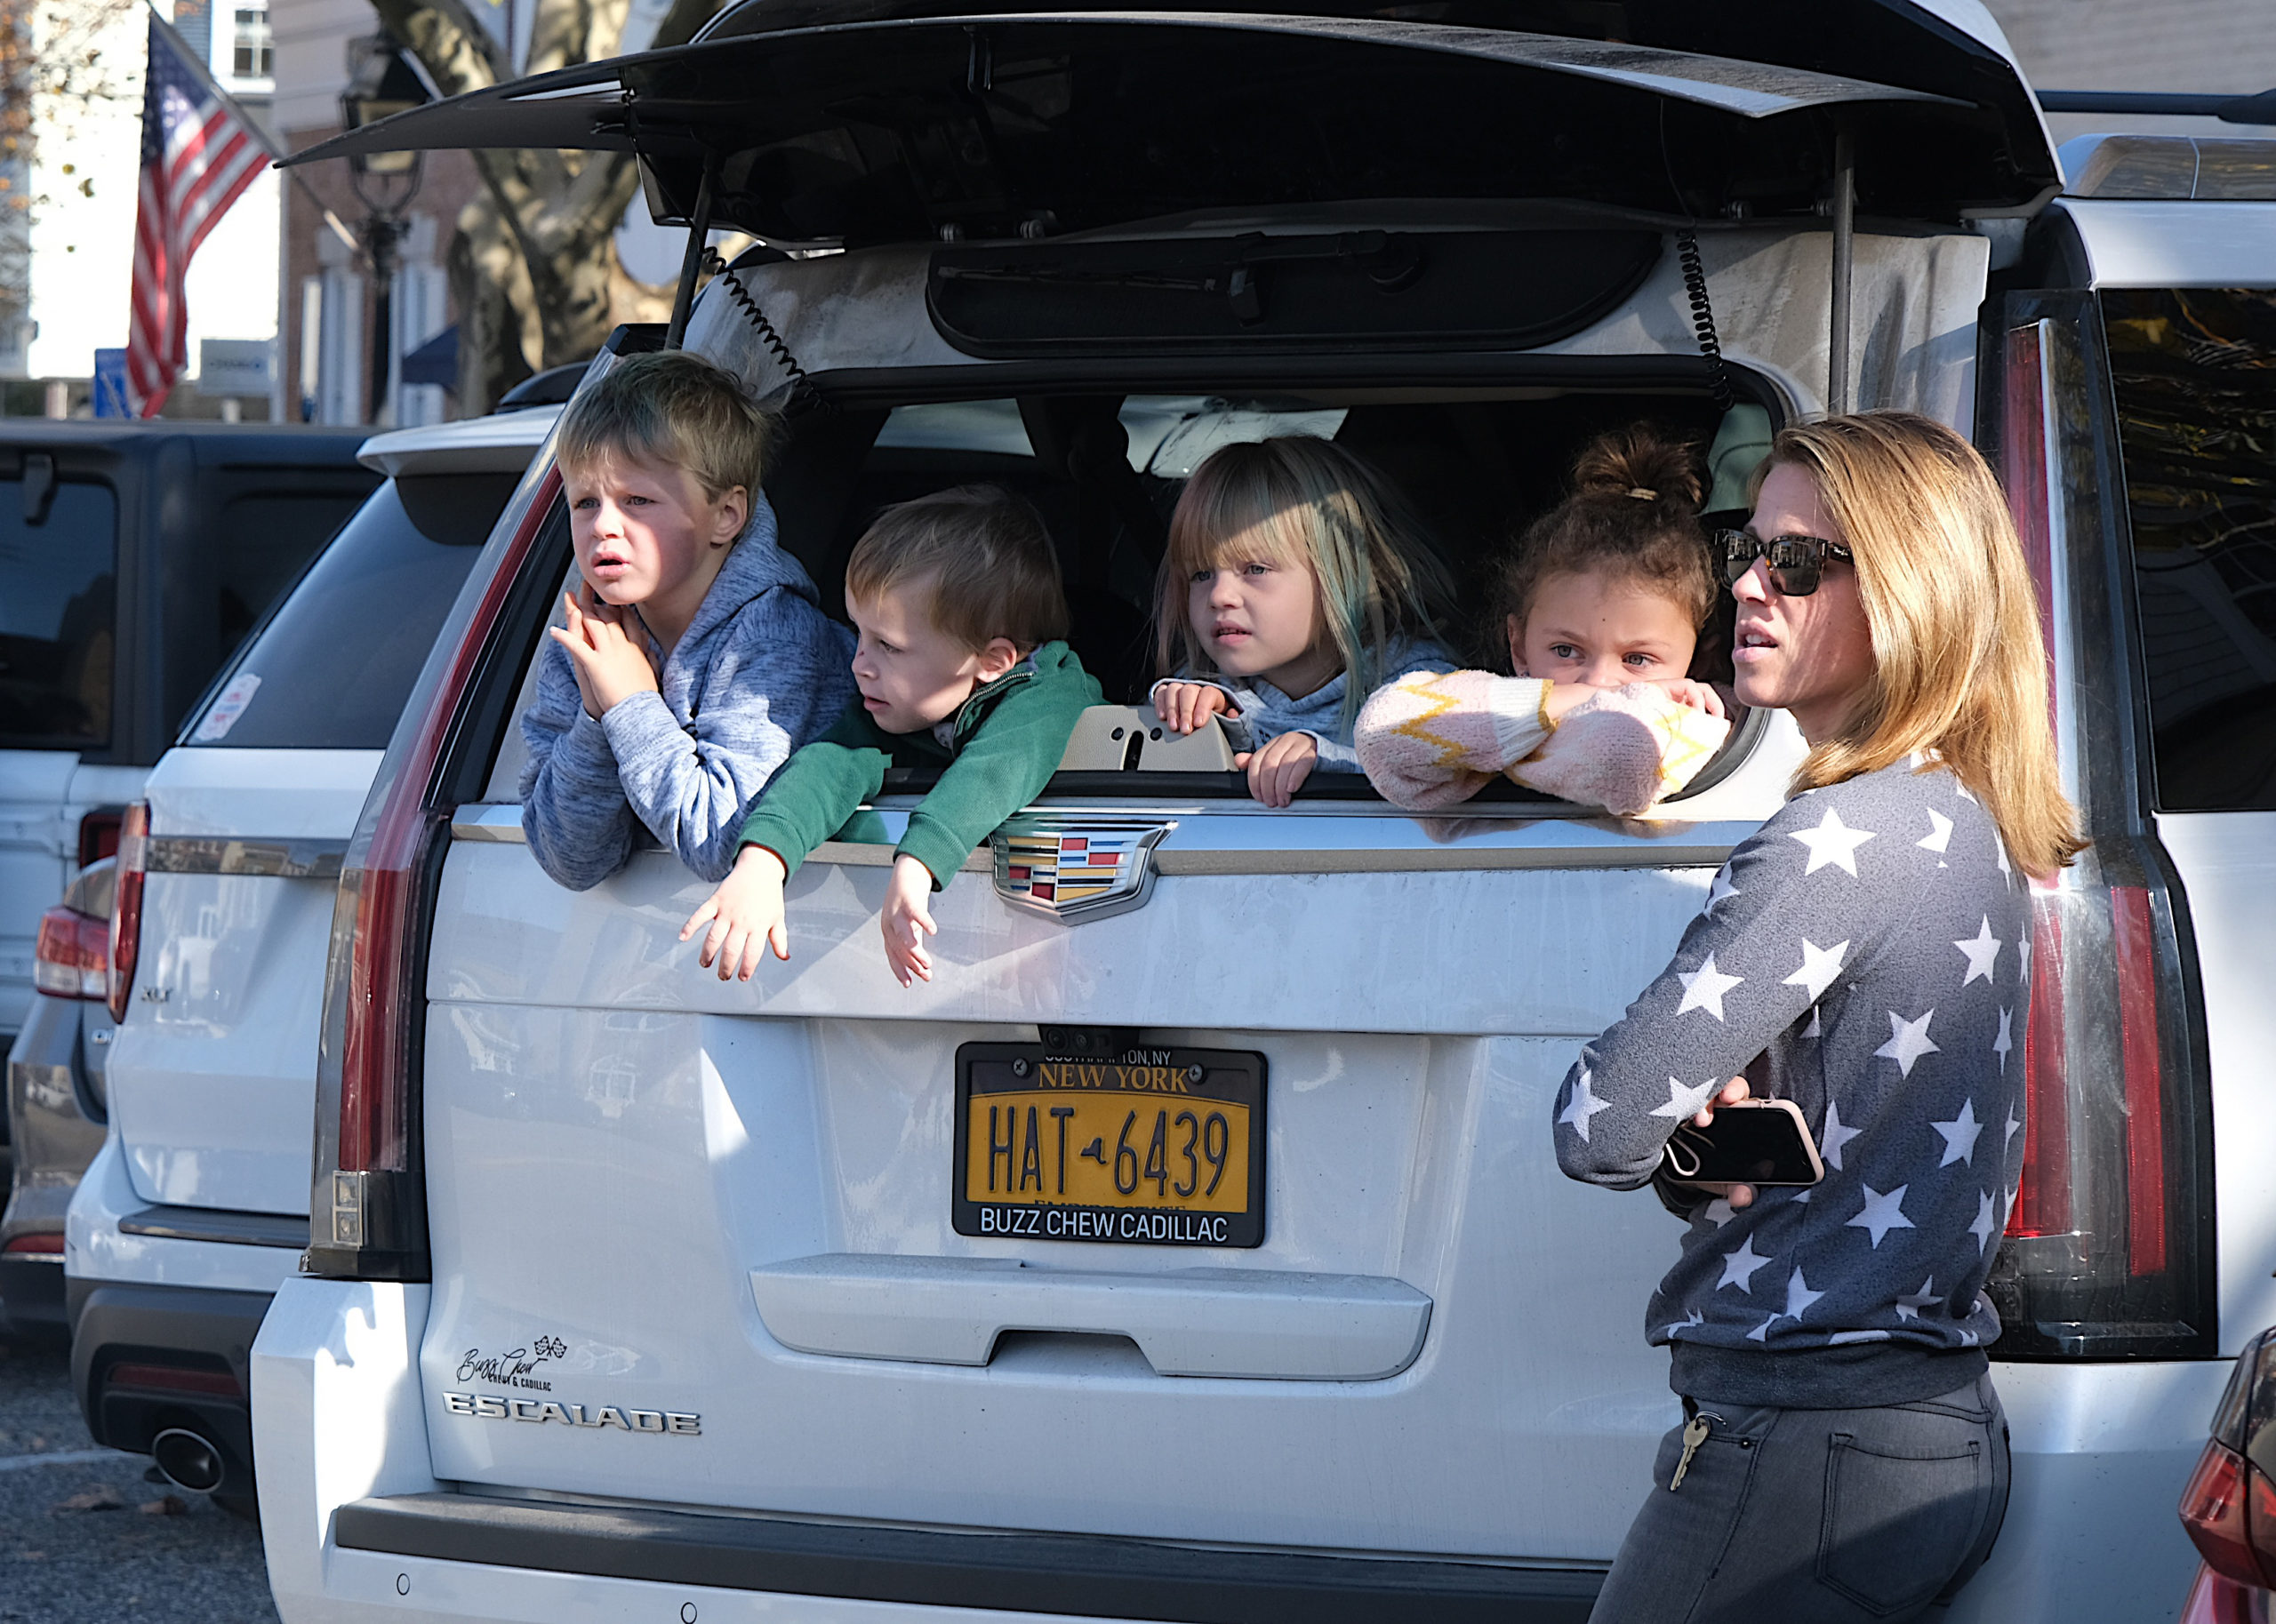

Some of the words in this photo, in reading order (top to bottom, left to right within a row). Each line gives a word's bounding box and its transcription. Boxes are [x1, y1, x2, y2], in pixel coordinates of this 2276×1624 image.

[1038, 1064, 1107, 1088] NEW
[1115, 1067, 1188, 1093] YORK
[989, 1105, 1075, 1195] HAT
[1114, 1110, 1229, 1197] 6439
[981, 1207, 1040, 1235] BUZZ
[1046, 1211, 1115, 1237] CHEW
[1120, 1213, 1228, 1243] CADILLAC
[456, 1348, 500, 1386] Buzz
[512, 1376, 519, 1388] &
[520, 1378, 552, 1392] CADILLAC
[443, 1391, 702, 1436] ESCALADE
